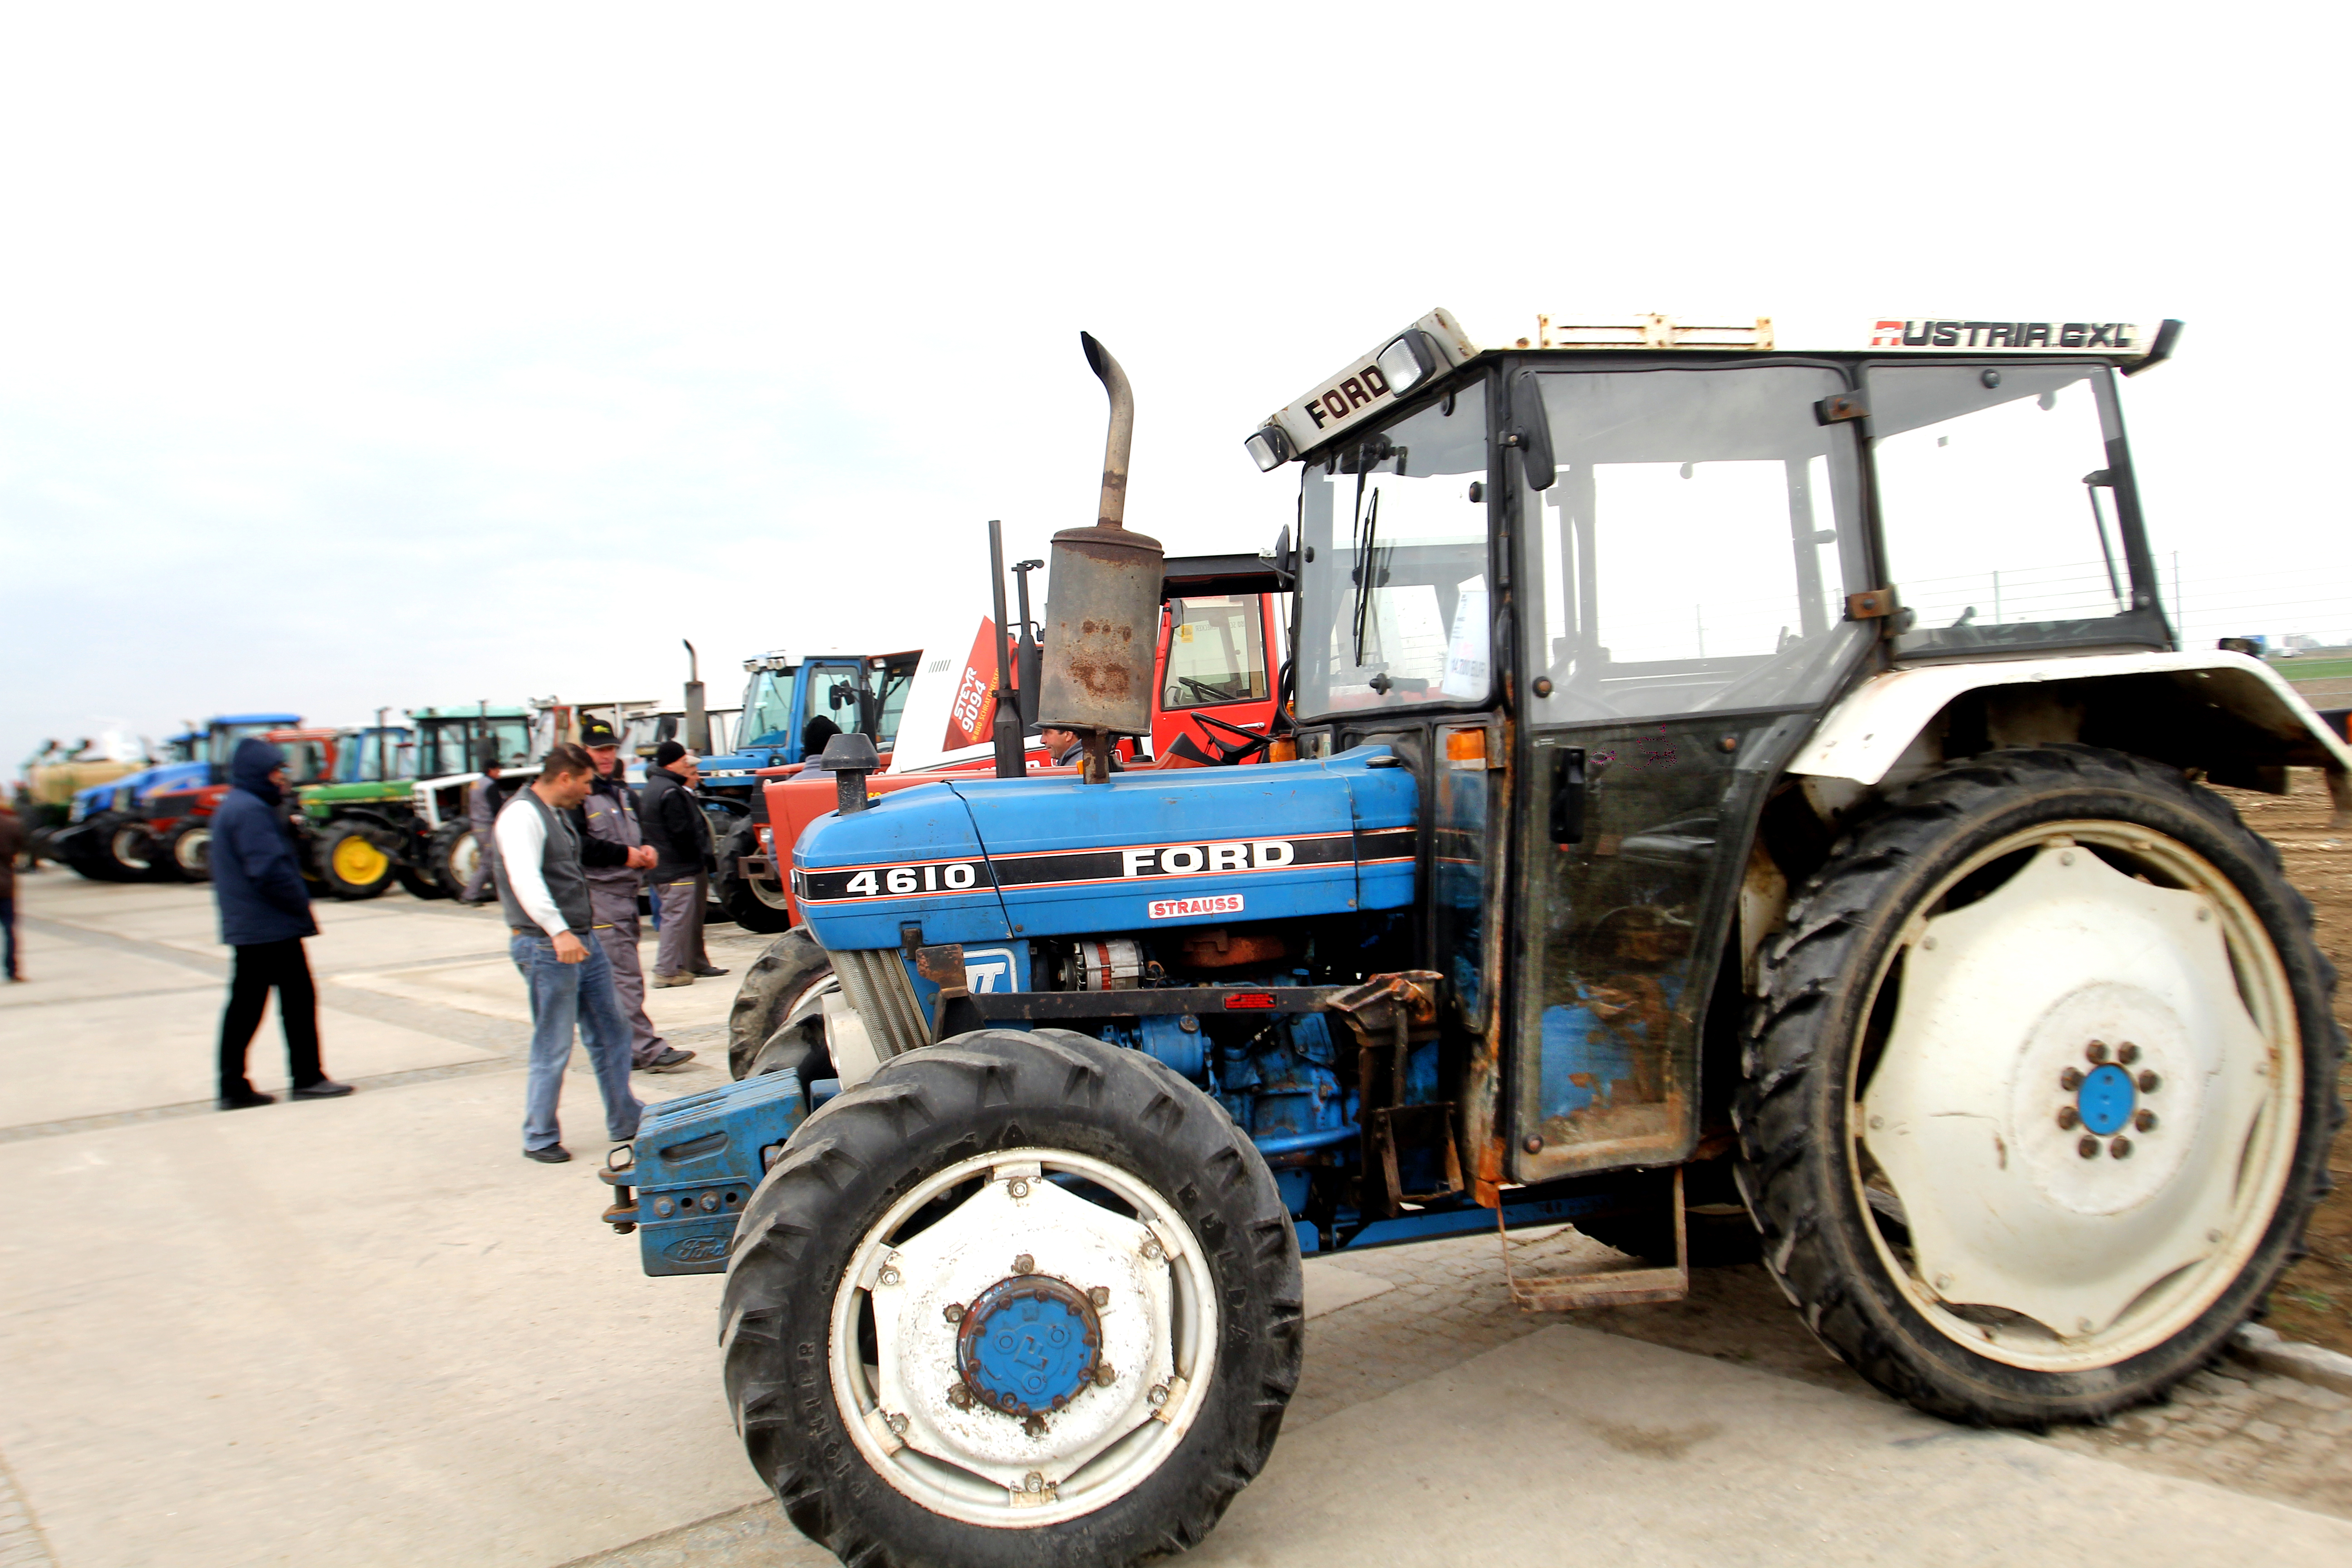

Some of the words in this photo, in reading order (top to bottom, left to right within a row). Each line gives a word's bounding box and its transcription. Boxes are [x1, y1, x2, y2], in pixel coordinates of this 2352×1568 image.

[1872, 320, 2053, 347] AUSTRIA
[2059, 323, 2134, 348] GXL
[1304, 364, 1391, 430] FORD
[954, 666, 977, 720] STEYR
[961, 679, 987, 733] 9094
[974, 721, 983, 738] BISO
[1122, 841, 1294, 877] FORD
[846, 863, 975, 896] 4610
[1154, 897, 1239, 916] STRAUSS
[677, 1237, 729, 1260] Ford
